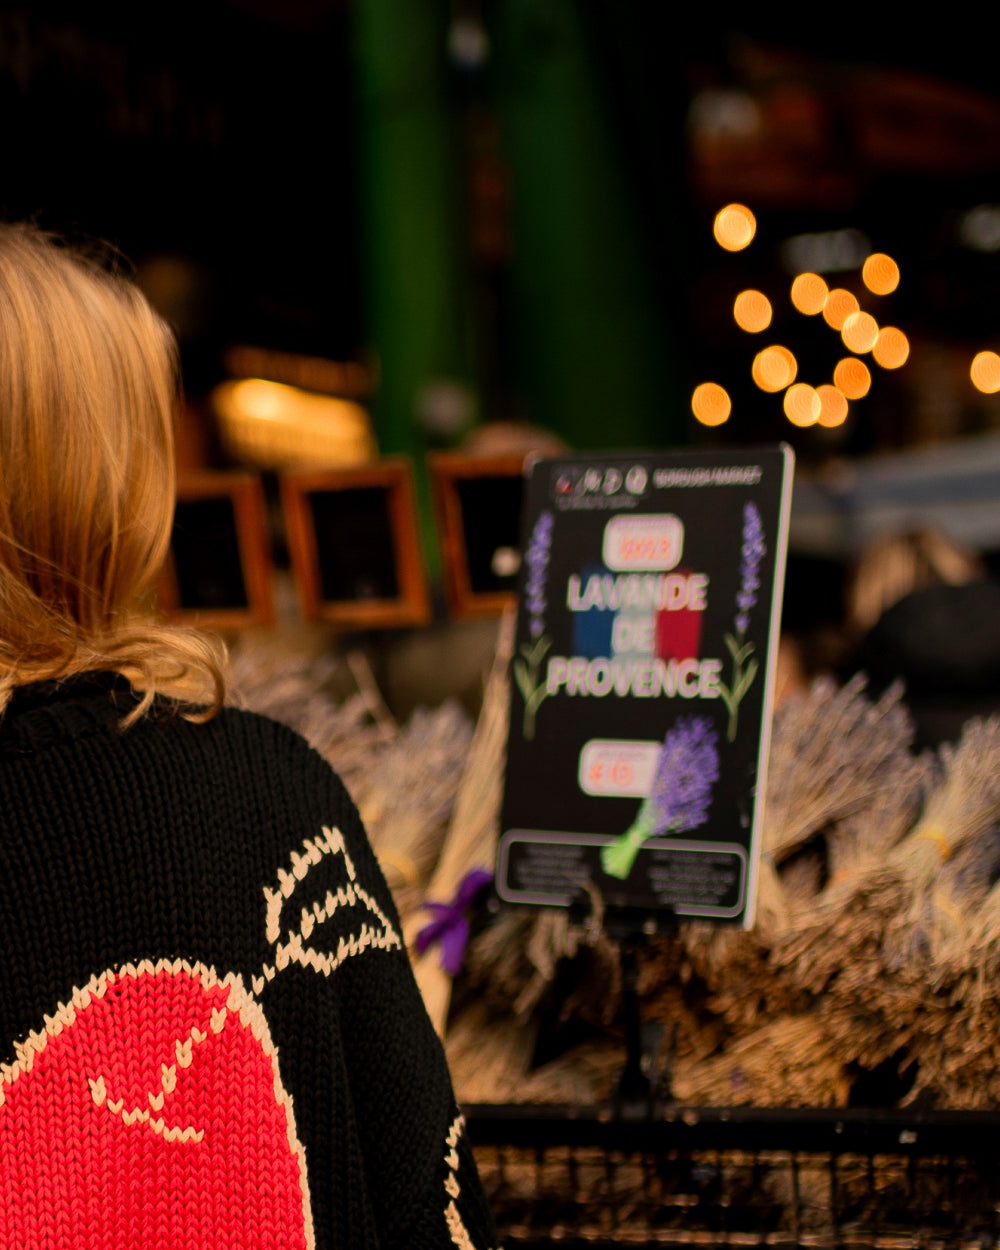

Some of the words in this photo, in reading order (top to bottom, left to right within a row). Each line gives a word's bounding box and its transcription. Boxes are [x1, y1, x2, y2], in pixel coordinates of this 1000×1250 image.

[567, 573, 709, 612] LAVANDE
[612, 615, 655, 653] DE
[546, 657, 723, 699] PROVENCE
